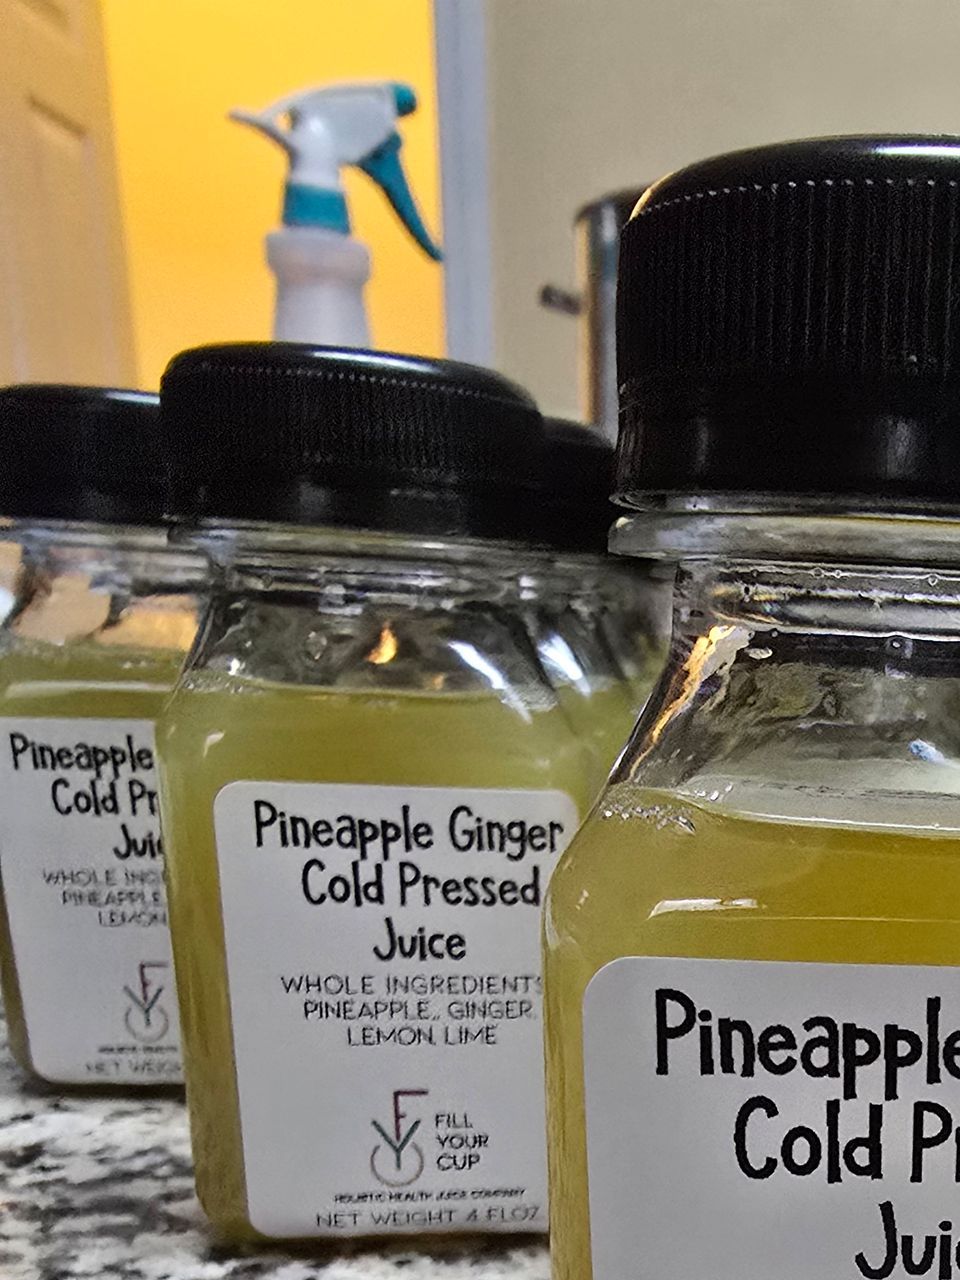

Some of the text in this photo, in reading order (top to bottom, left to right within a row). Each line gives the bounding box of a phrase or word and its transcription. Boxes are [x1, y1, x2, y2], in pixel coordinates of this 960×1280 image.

[10, 732, 154, 780] Pineapple
[51, 778, 119, 817] Cold
[254, 800, 564, 862] Pineapple Ginger
[302, 859, 541, 907] Cold Pressed
[373, 917, 466, 962] Juice
[281, 974, 375, 995] WHOLE
[445, 1025, 498, 1046] LIME
[435, 1113, 473, 1128] FILL
[436, 1134, 489, 1149] YOUR
[733, 1095, 882, 1184] Cold
[436, 1153, 480, 1171] CUP
[316, 1210, 361, 1228] NET
[371, 1209, 458, 1227] WEIGHT
